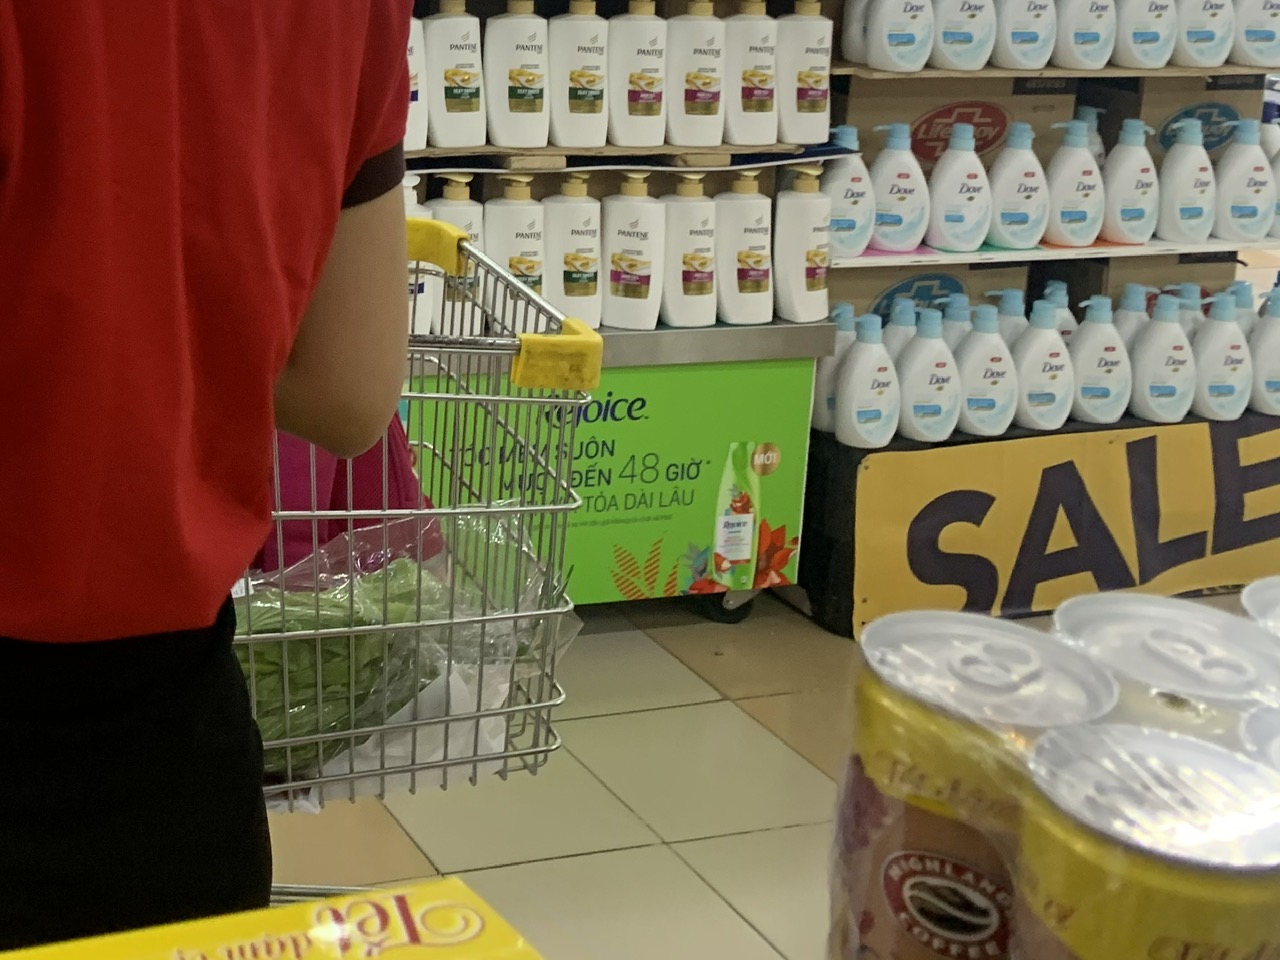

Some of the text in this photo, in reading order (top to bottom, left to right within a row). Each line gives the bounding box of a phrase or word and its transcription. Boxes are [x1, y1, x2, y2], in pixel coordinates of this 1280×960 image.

[903, 1, 925, 13] Dove
[960, 0, 985, 13] Dove
[1027, 0, 1049, 12] Dove
[1089, 1, 1109, 13] Dove
[1148, 0, 1169, 13] Dove
[1202, 0, 1225, 11] Dove
[920, 124, 999, 140] Lifeoy
[1076, 181, 1096, 192] Dove
[1135, 179, 1154, 190] Dove
[1193, 178, 1211, 189] Dove
[1246, 177, 1268, 188] Dove
[844, 188, 866, 199] Dove
[888, 184, 915, 195] Dove
[958, 183, 983, 194] Dove
[1017, 183, 1039, 194] Dove
[617, 228, 649, 239] PANTENE
[1097, 357, 1120, 368] Dove
[1165, 356, 1187, 367] Dove
[1223, 355, 1244, 366] Dove
[1042, 361, 1065, 373] Dove
[928, 373, 951, 385] Dove
[983, 368, 1006, 379] Dove
[871, 378, 891, 390] Dove
[570, 462, 613, 488] ĐẾN
[618, 452, 660, 485] 48
[582, 490, 620, 513] TỎA
[624, 488, 654, 511] DÀI
[658, 486, 696, 508] LÂU
[907, 420, 1280, 618] SALE
